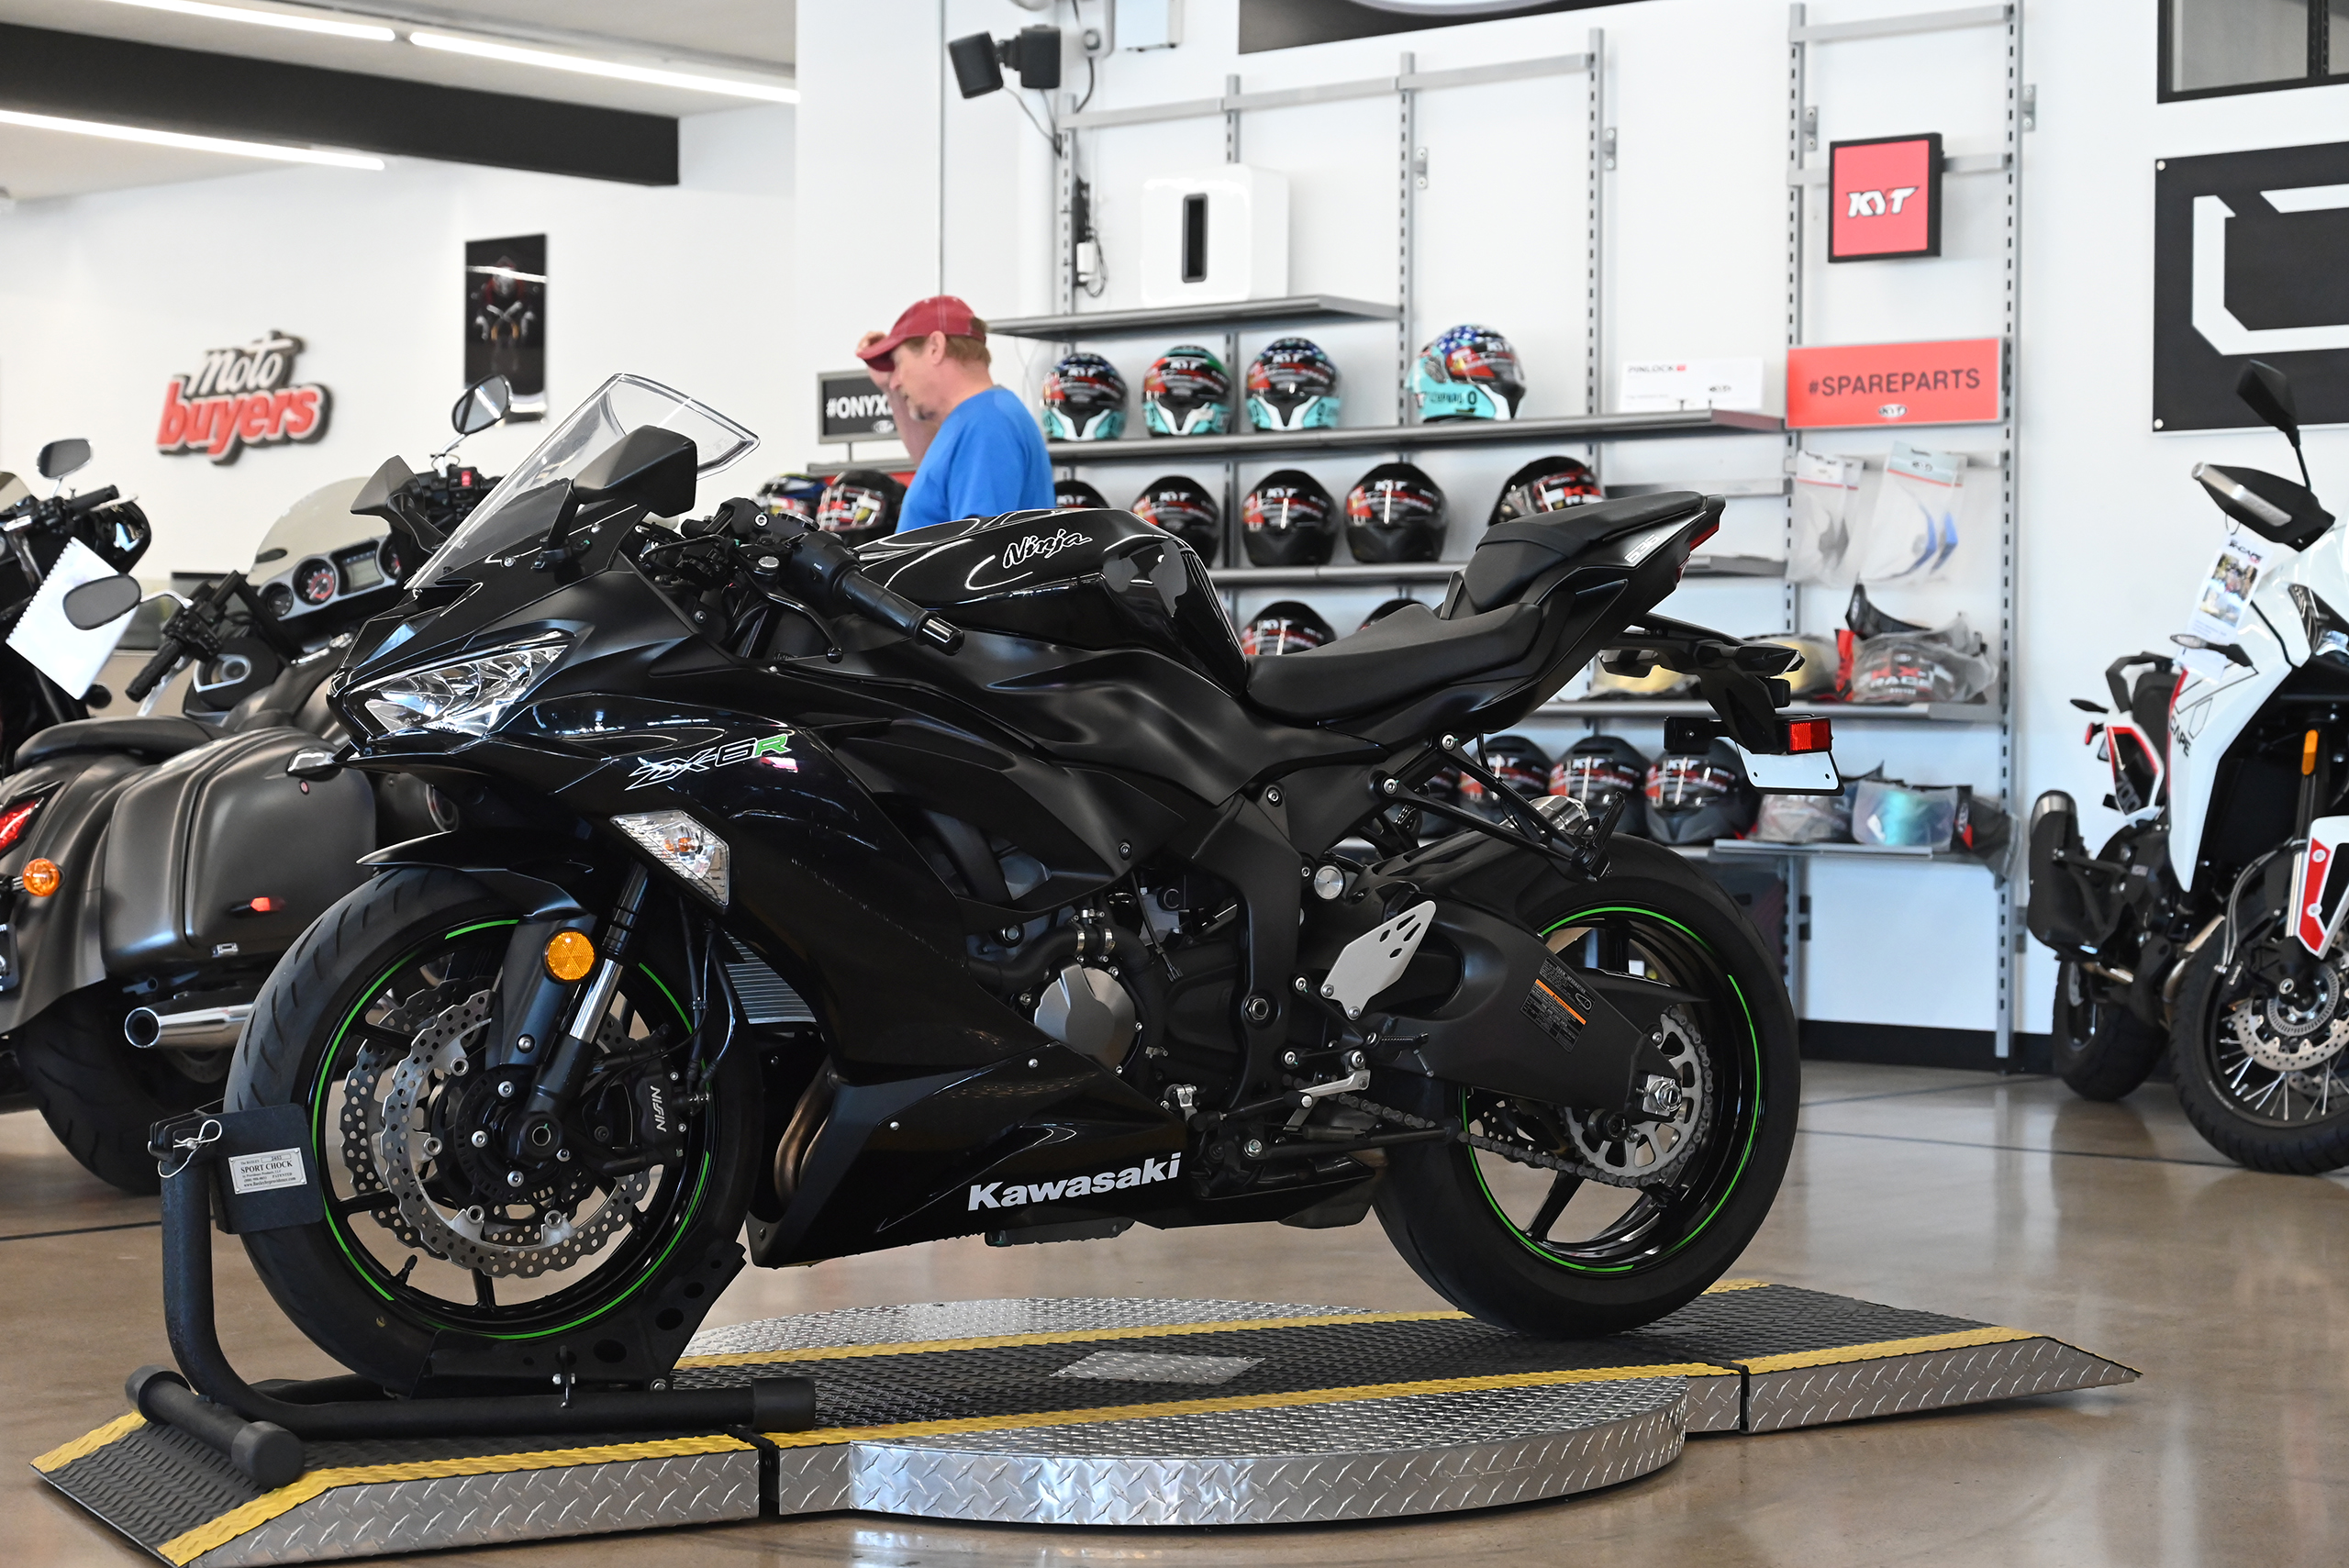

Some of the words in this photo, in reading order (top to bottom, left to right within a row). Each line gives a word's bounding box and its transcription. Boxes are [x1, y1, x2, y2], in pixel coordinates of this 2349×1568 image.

[1846, 186, 1920, 218] KYT
[1809, 368, 1981, 397] #SPAREPARTS
[156, 377, 321, 461] buyers
[826, 394, 893, 419] #ONYX
[1002, 528, 1093, 569] Ninja
[1624, 533, 1661, 563] 636
[624, 733, 792, 791] ZX-6R
[650, 1085, 667, 1132] NISSIN
[240, 1164, 264, 1173] SPORT
[265, 1160, 293, 1172] CHOCK
[968, 1151, 1182, 1211] Kawasaki
